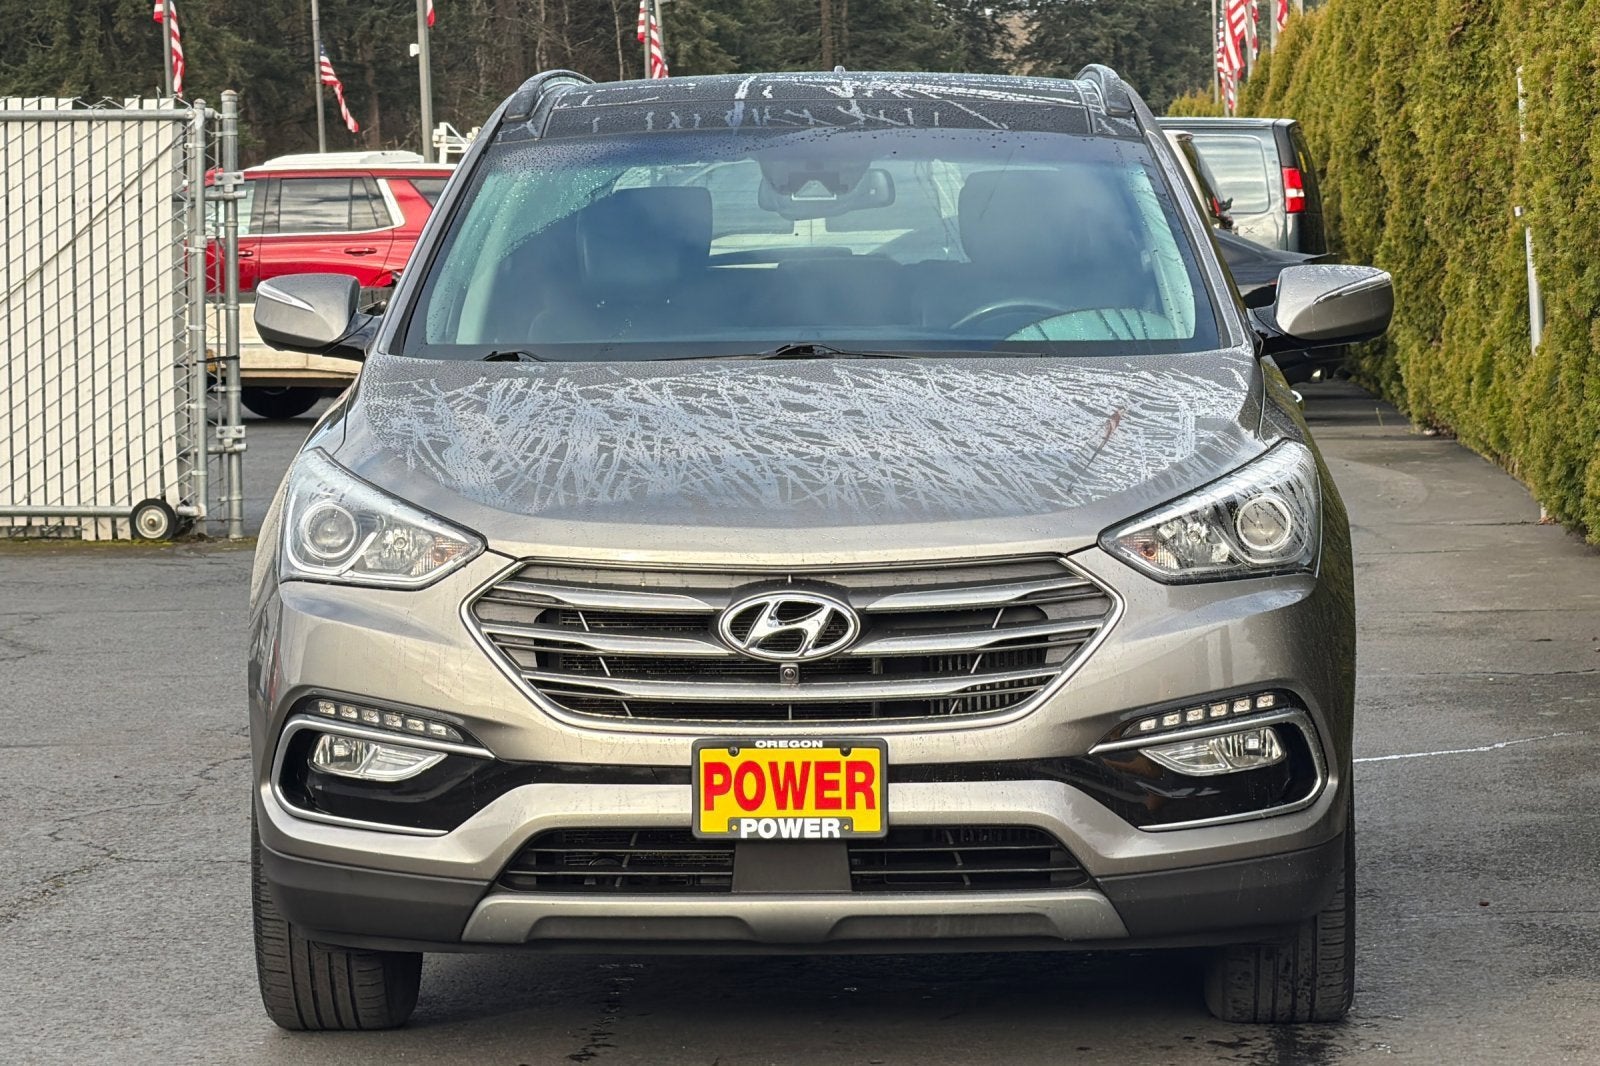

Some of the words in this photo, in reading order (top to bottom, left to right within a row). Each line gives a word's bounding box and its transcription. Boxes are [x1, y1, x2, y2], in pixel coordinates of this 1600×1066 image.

[755, 740, 823, 748] OREGON
[704, 761, 876, 811] POWER
[740, 818, 841, 838] POWER
